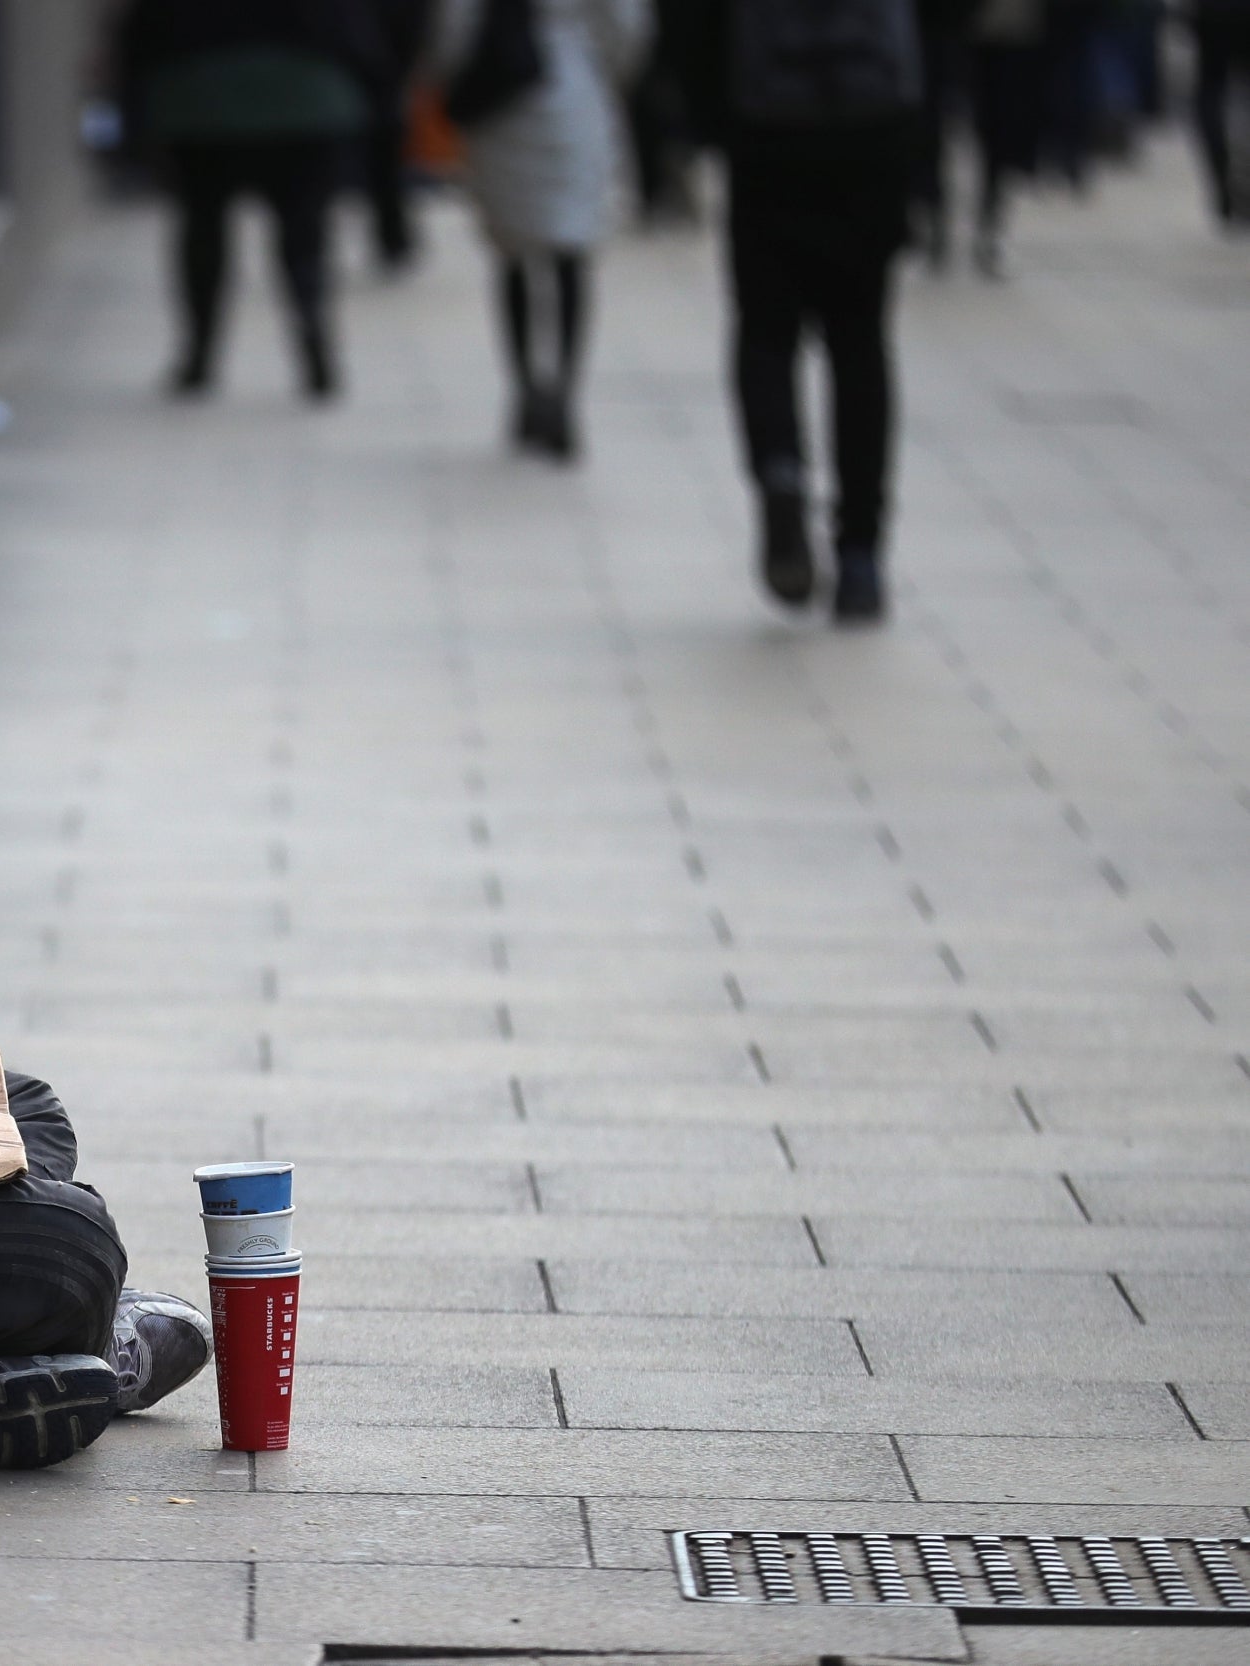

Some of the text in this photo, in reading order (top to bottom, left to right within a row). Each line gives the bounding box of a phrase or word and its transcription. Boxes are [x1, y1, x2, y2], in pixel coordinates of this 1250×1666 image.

[237, 1237, 280, 1254] FRESHLY GROUND
[266, 1298, 274, 1352] STARBUCKS
